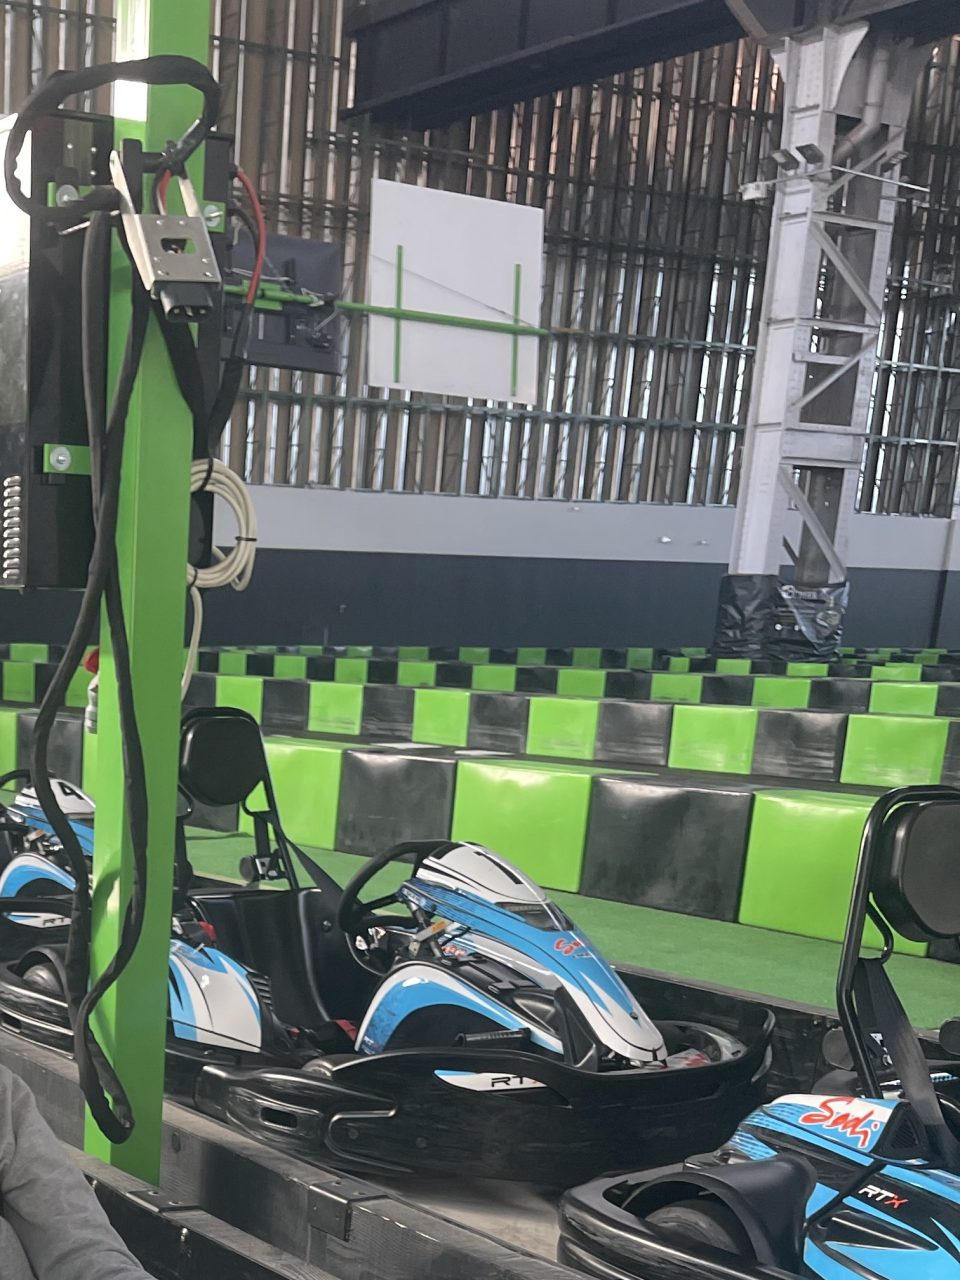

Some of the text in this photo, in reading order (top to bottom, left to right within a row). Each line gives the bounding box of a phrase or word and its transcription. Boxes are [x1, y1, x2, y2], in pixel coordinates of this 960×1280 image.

[42, 916, 67, 927] RT
[490, 1075, 539, 1089] RT
[800, 1096, 880, 1148] Sodi
[858, 1184, 909, 1209] RTX
